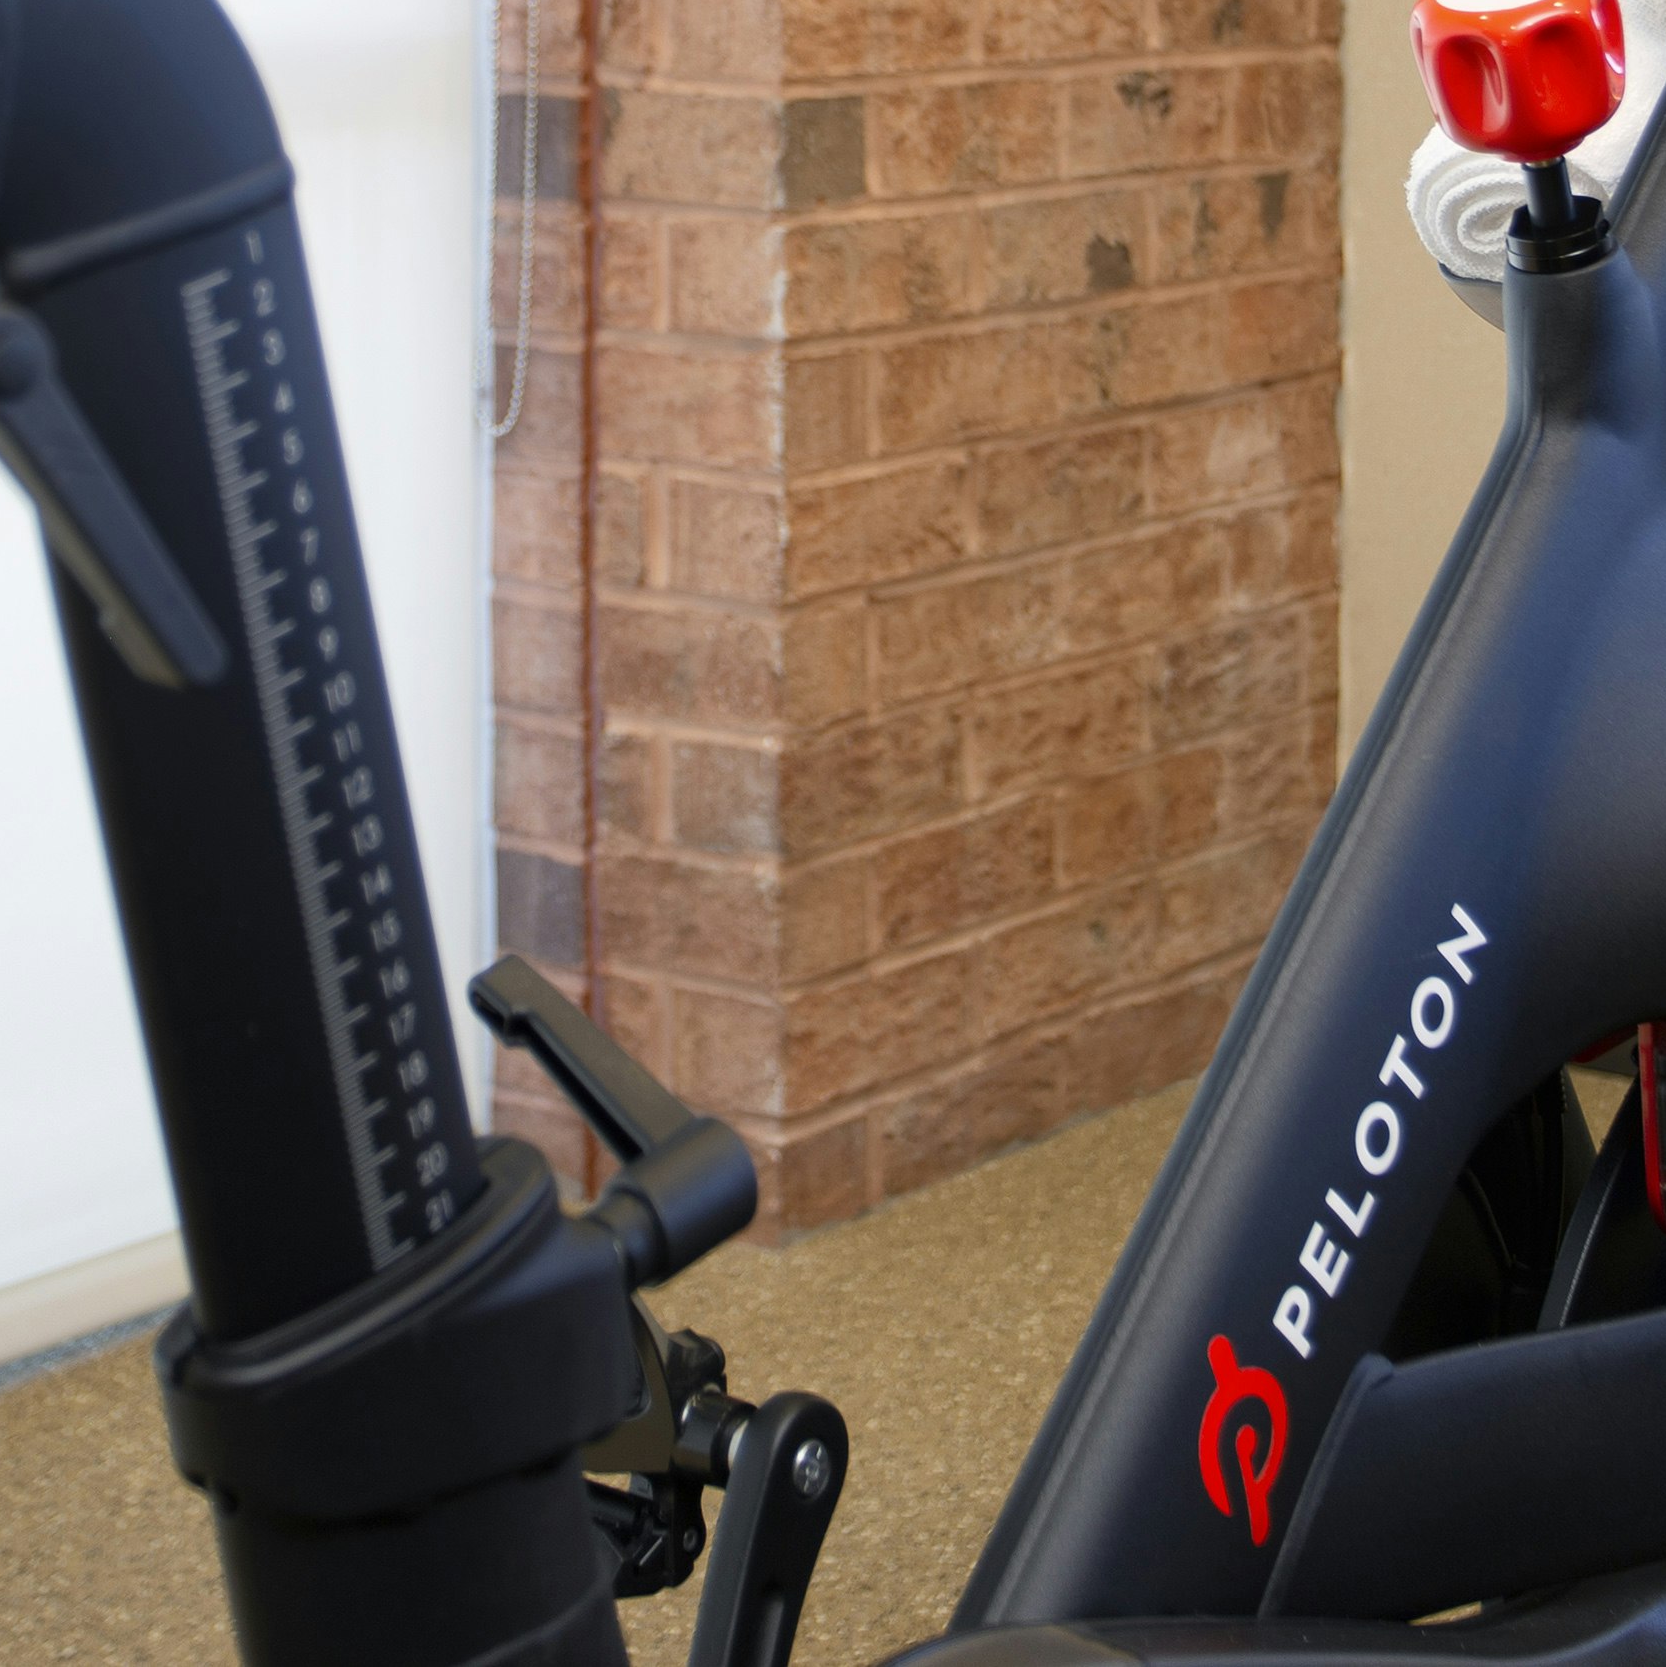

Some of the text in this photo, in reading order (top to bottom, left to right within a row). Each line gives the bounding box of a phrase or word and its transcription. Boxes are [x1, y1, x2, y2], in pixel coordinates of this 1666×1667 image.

[253, 277, 276, 317] 2
[263, 328, 285, 366] 3
[274, 381, 294, 414] 4
[293, 478, 313, 514] 6
[300, 527, 319, 566] 7
[319, 626, 338, 663] 9
[323, 671, 356, 714] 10
[342, 765, 374, 811] 12
[360, 864, 391, 905] 14
[379, 955, 410, 1000] 16
[389, 1002, 416, 1047] 17
[1272, 902, 1489, 1360] PELOTON
[416, 1141, 449, 1188] 20
